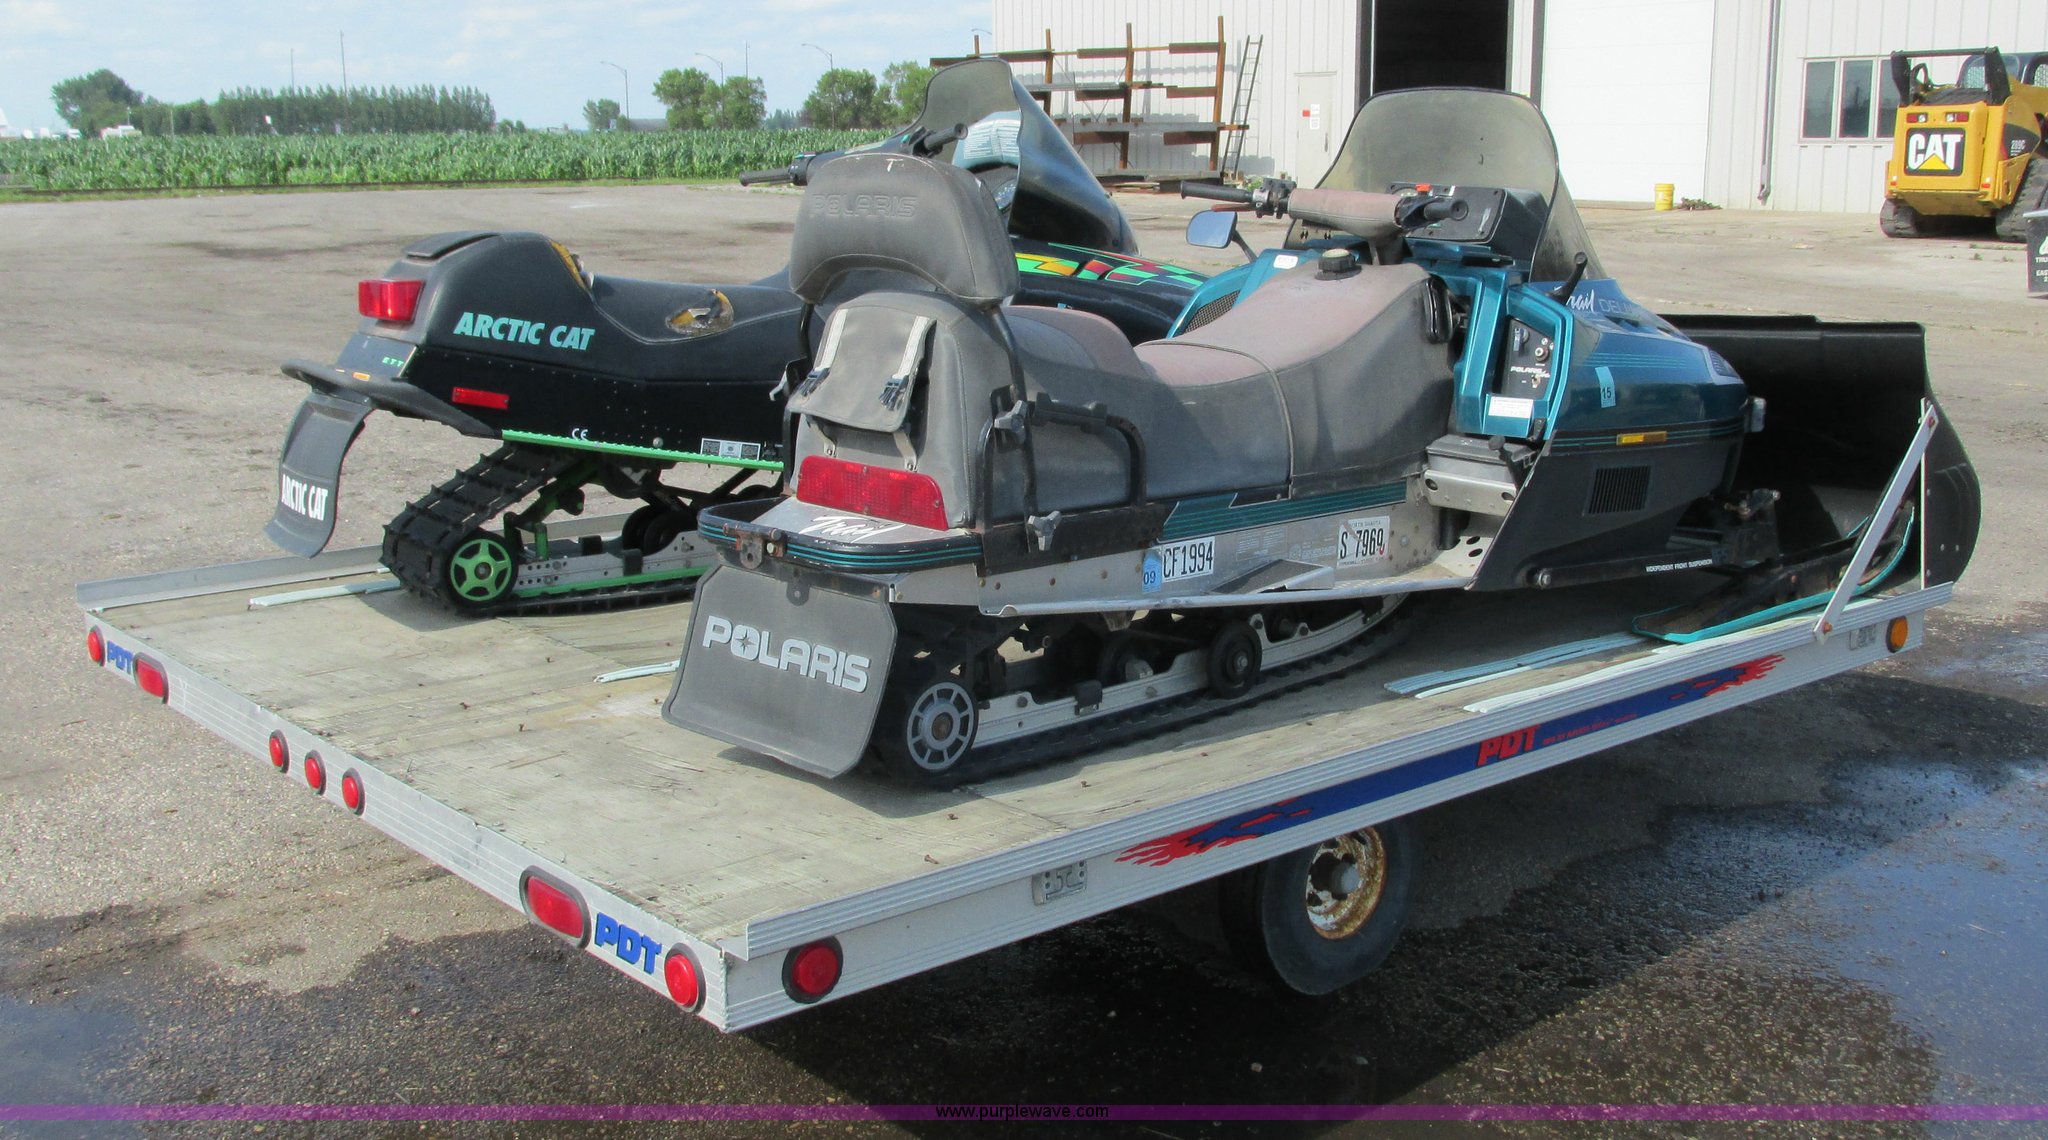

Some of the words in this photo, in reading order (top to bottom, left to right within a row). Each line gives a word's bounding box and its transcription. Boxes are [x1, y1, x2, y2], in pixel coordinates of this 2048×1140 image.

[1908, 133, 1962, 171] CAT
[811, 193, 918, 218] POLARIS
[453, 312, 546, 345] ARCTIC
[549, 325, 596, 350] CAT
[1601, 387, 1612, 399] 15
[281, 474, 307, 515] ARCTIC
[308, 486, 328, 520] CAT
[1163, 541, 1213, 578] CF1994
[1340, 531, 1348, 559] S
[1143, 571, 1156, 585] 09
[1674, 562, 1687, 570] FRONT
[106, 640, 133, 675] PDT
[703, 615, 871, 693] POLARIS
[1477, 724, 1541, 767] PDT
[594, 912, 662, 975] PDT
